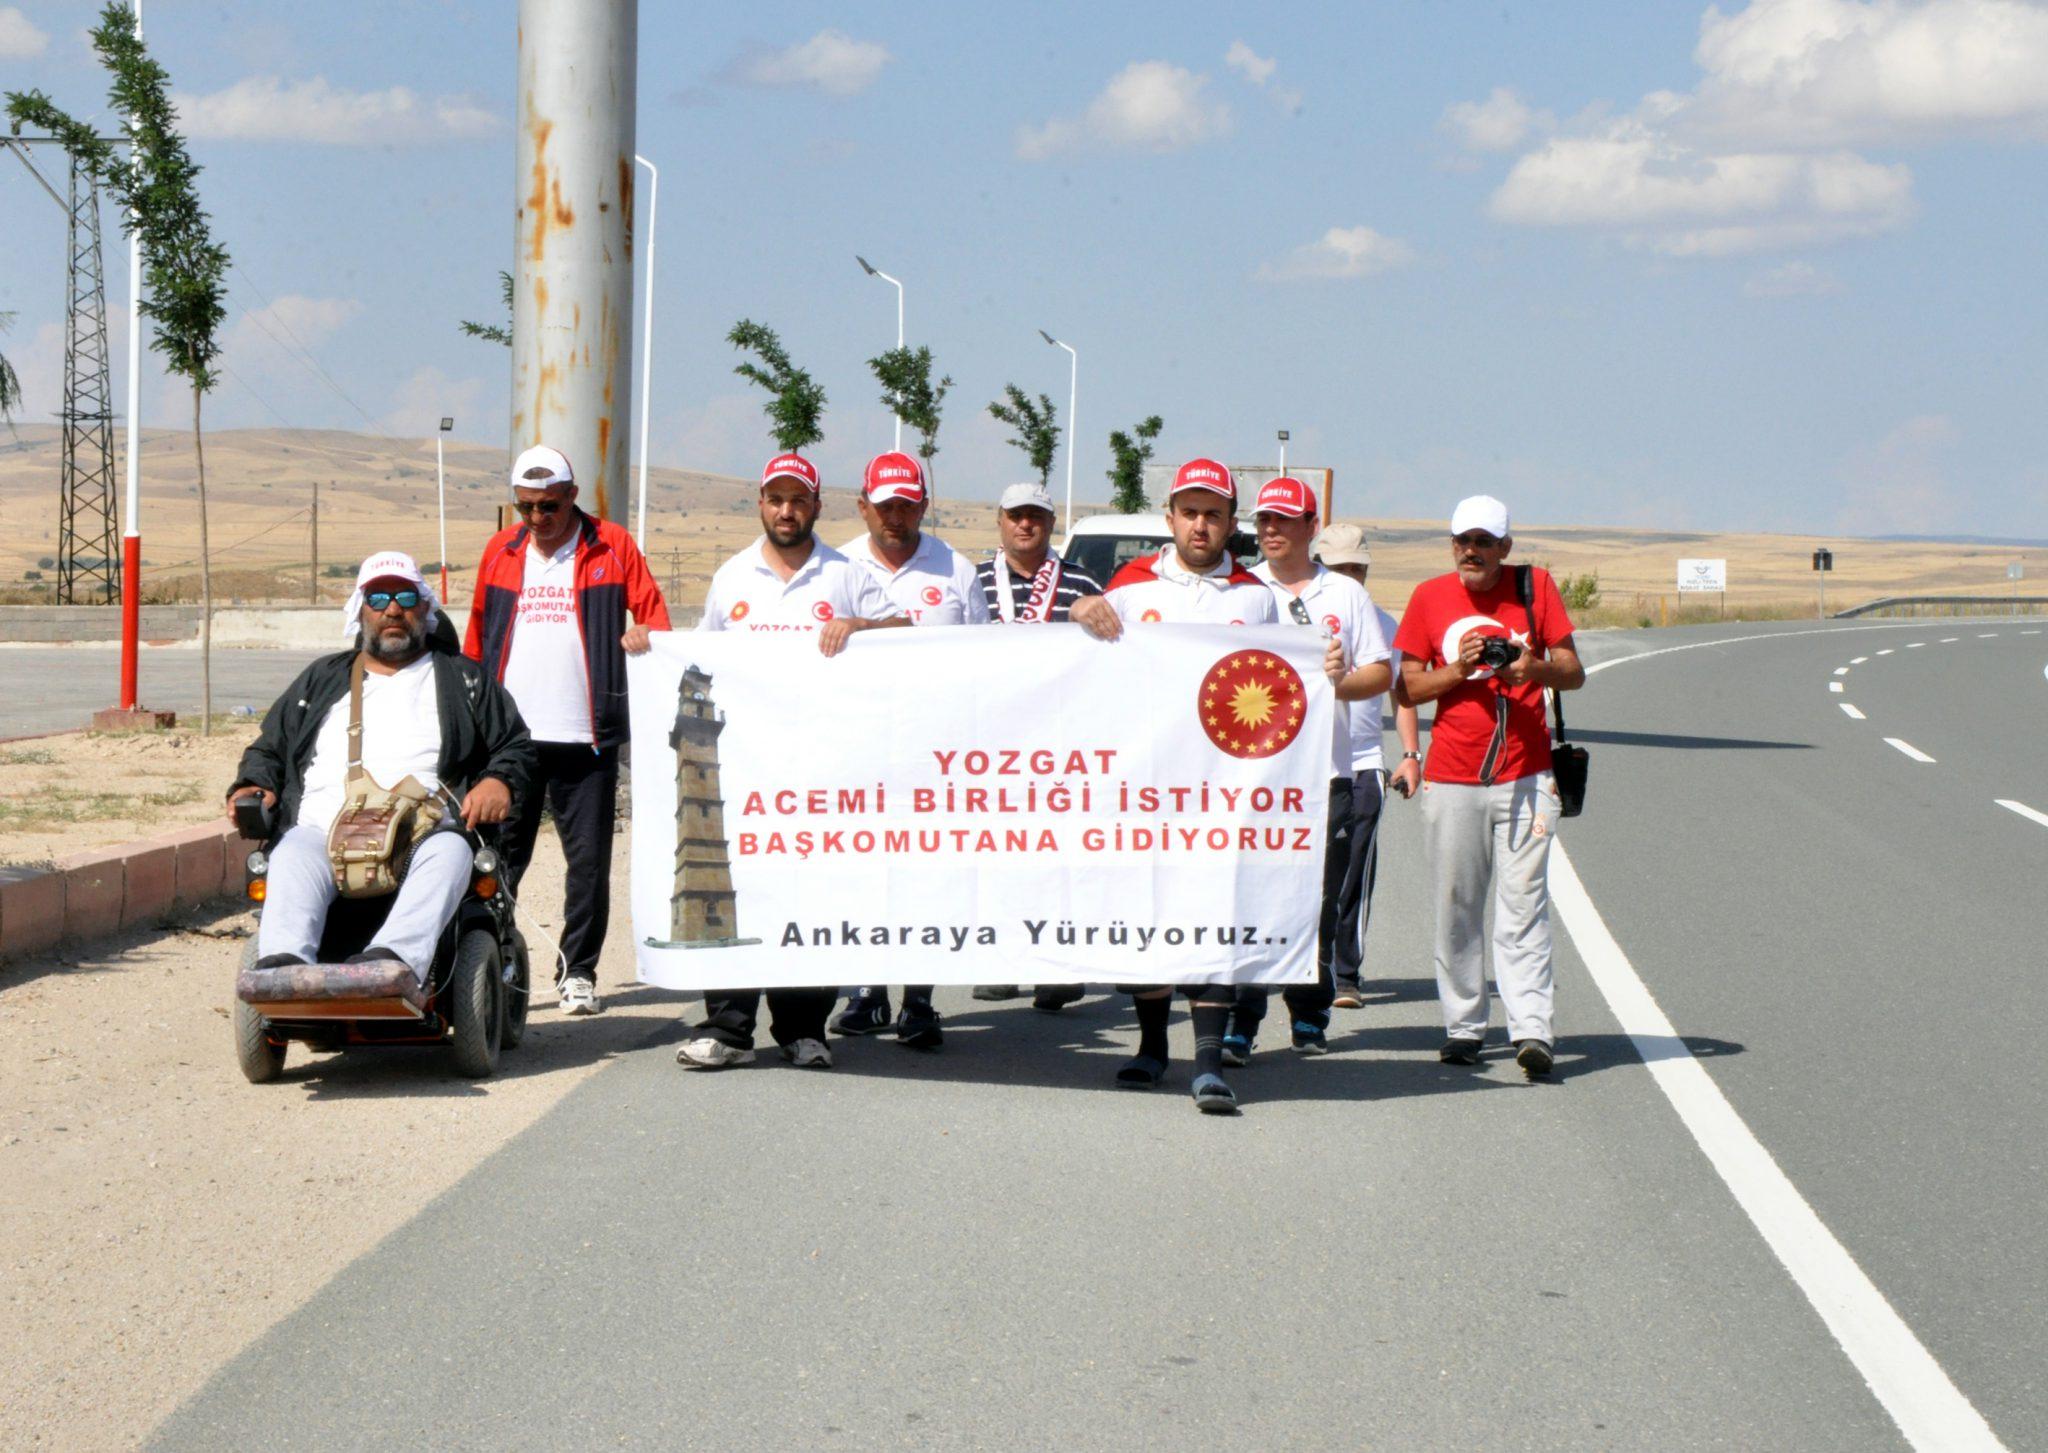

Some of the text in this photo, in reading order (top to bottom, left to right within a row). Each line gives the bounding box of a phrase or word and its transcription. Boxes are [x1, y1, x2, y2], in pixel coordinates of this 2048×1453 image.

[878, 466, 912, 480] TÜRKİYE
[1186, 468, 1220, 481] TÜRKİYE
[1261, 487, 1293, 499] TÜRKİYE
[933, 749, 1118, 776] YOZGAT
[743, 780, 1305, 816] ACEMİ BİRLİĞİ İSTİYOR
[738, 822, 1312, 860] BAŞKOMUTANA GİDİYORUZ
[780, 919, 1288, 952] Ankaraya Yürüyoruz..
